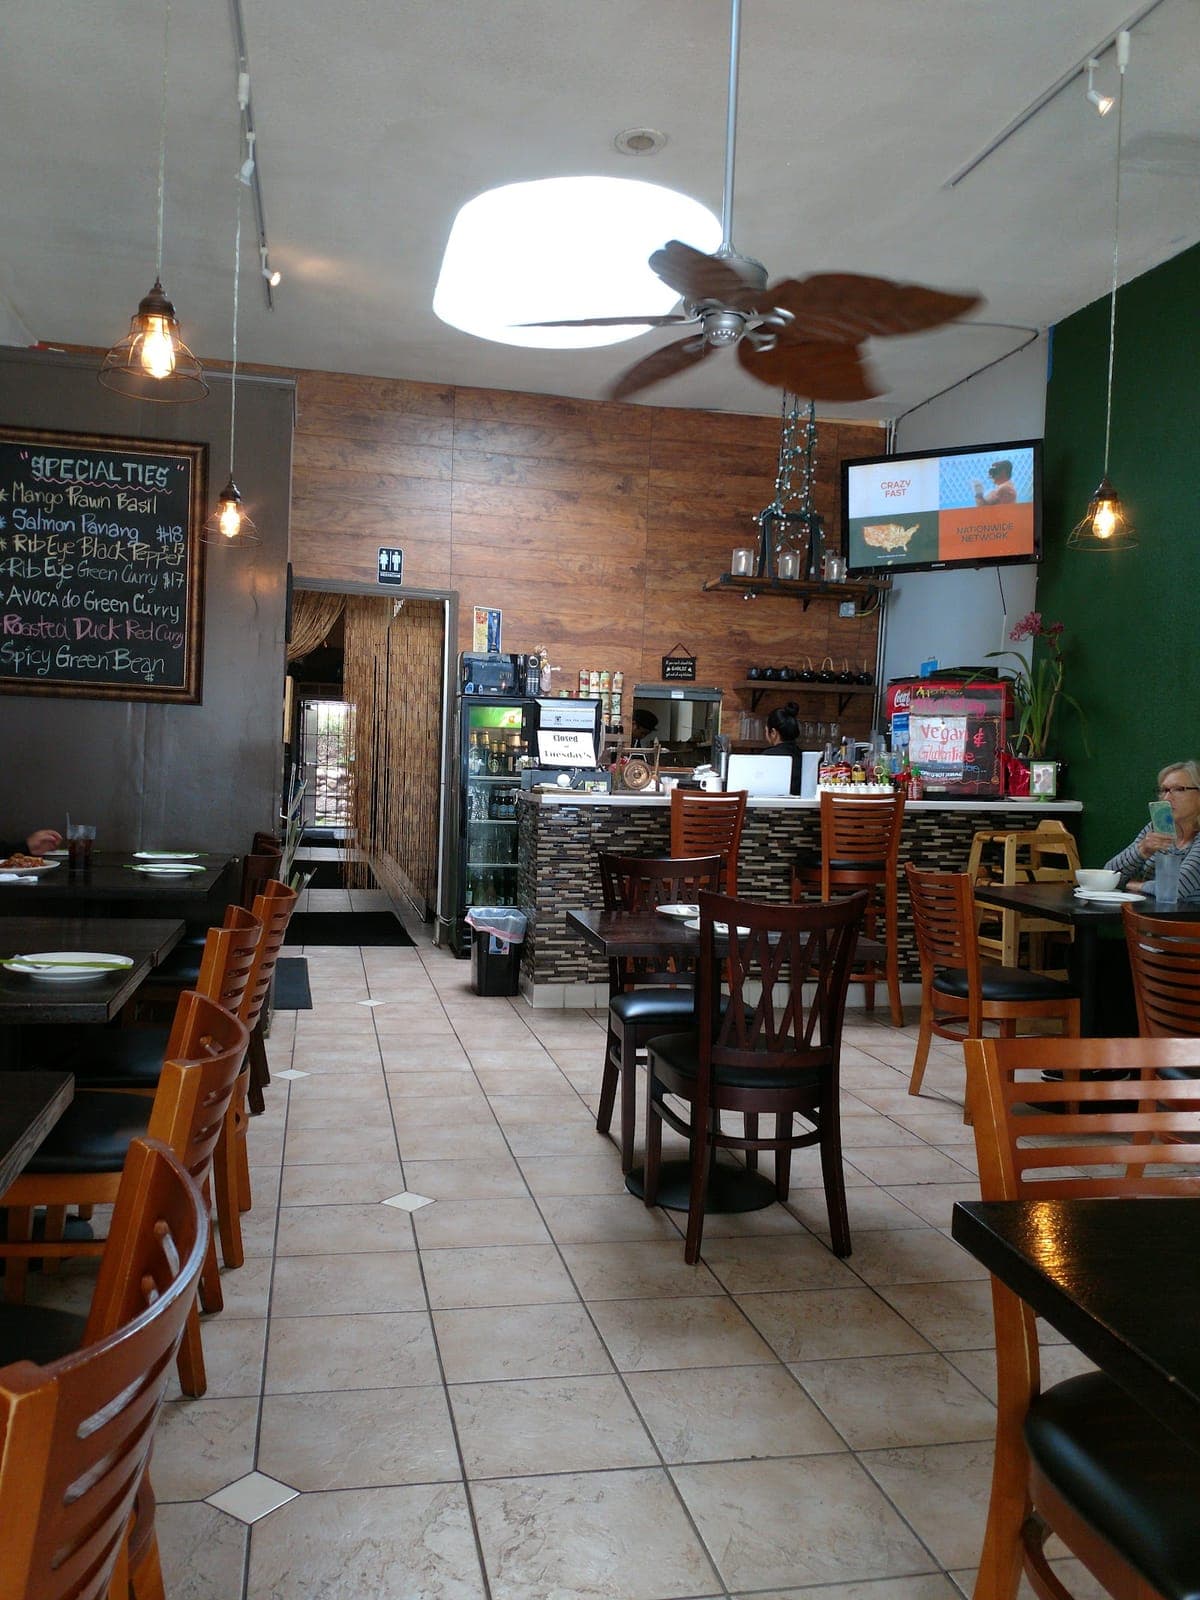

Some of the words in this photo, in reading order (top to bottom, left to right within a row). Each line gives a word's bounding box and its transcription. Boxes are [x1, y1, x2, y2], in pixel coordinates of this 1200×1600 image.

[12, 480, 63, 513] Mango
[65, 485, 111, 509] Prawn
[116, 493, 157, 514] Basil
[881, 480, 911, 489] CRAZY
[885, 488, 907, 498] FAST
[13, 508, 75, 532] Salmon
[81, 513, 139, 547] Panang
[956, 522, 1014, 534] NATIONWIDE
[961, 532, 1008, 543] NETWORK
[76, 536, 128, 561] Black
[130, 542, 184, 568] Pepper
[77, 560, 118, 580] Green
[121, 563, 158, 593] Curry
[163, 572, 184, 589] $17
[83, 589, 129, 614] Green
[133, 593, 179, 624] Curry
[3, 614, 71, 640] Roasted
[73, 617, 122, 640] Duck
[126, 620, 153, 640] Red
[1, 640, 51, 675] Spicy
[56, 645, 109, 670] Green
[105, 648, 164, 673] Bean
[920, 724, 968, 746] Vegan
